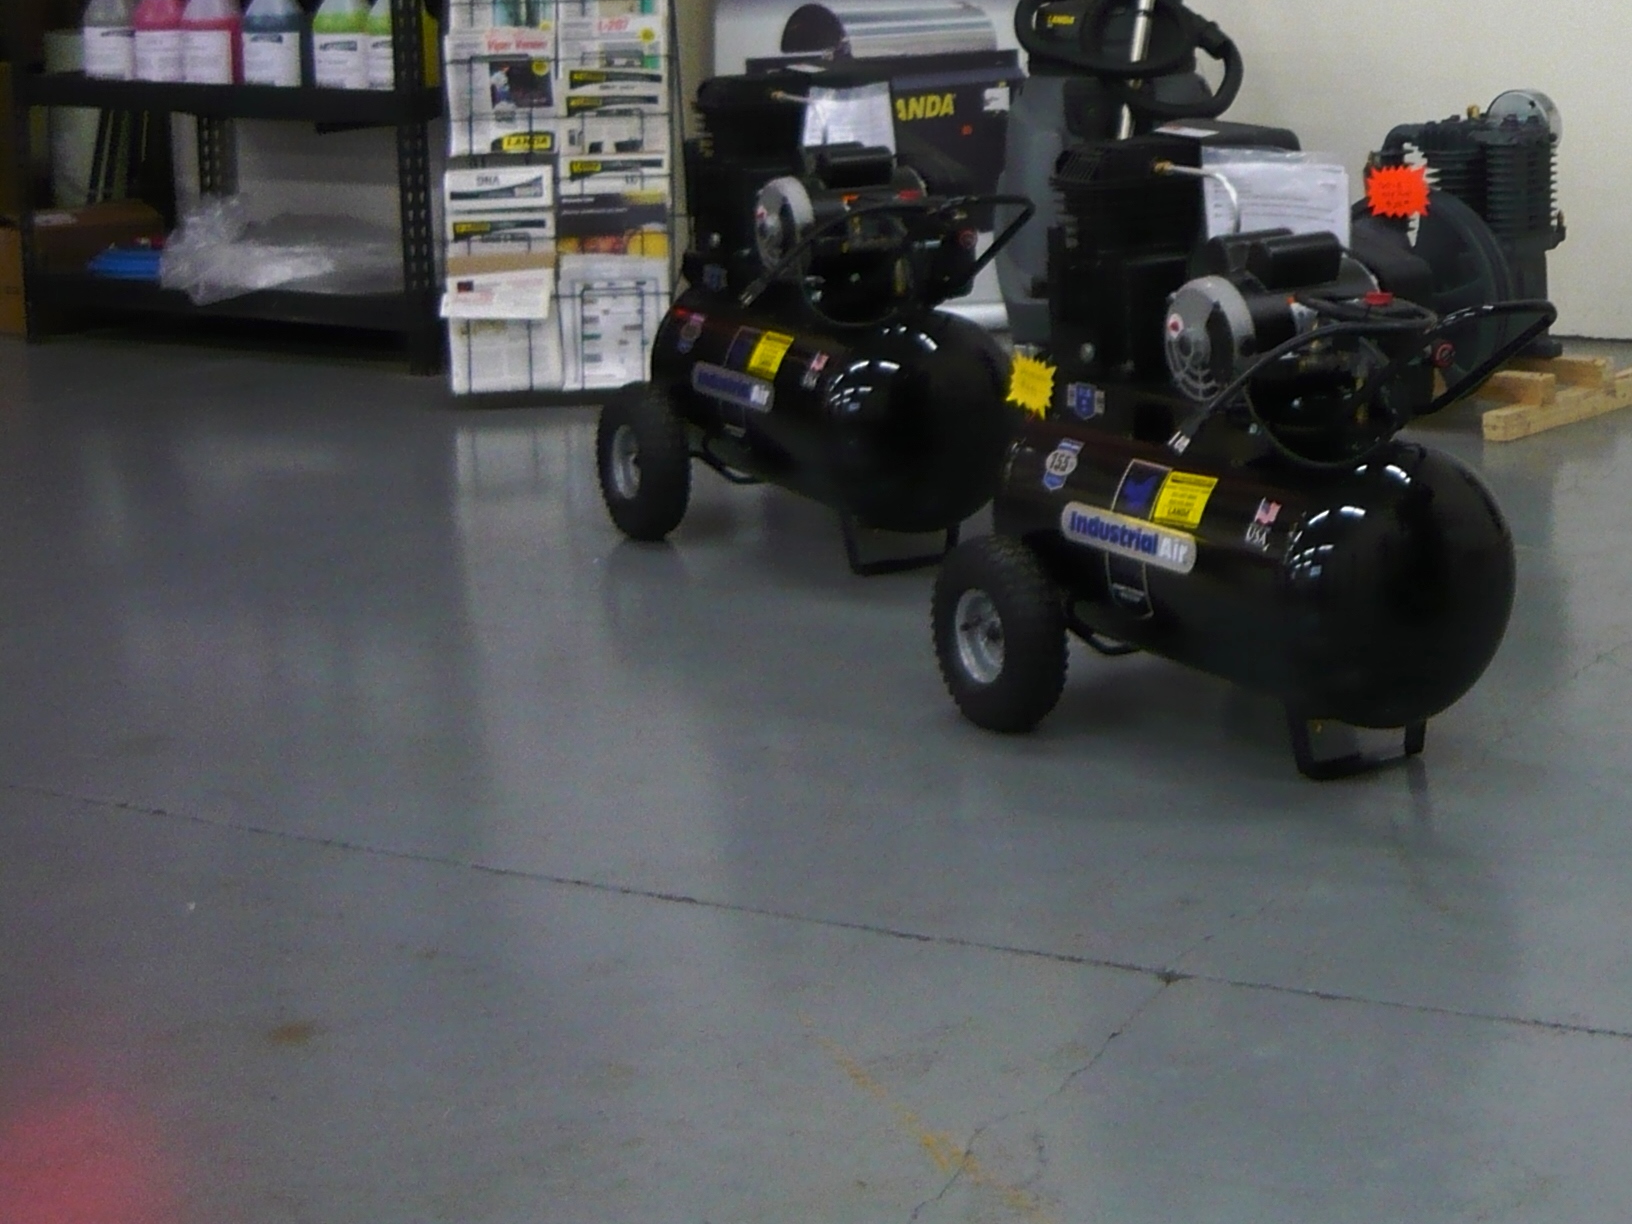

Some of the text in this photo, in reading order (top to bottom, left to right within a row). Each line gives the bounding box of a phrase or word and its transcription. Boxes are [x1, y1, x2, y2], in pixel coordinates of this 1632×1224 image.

[896, 93, 955, 121] ANDA
[1049, 452, 1070, 472] 155
[1070, 511, 1158, 555] Industrial
